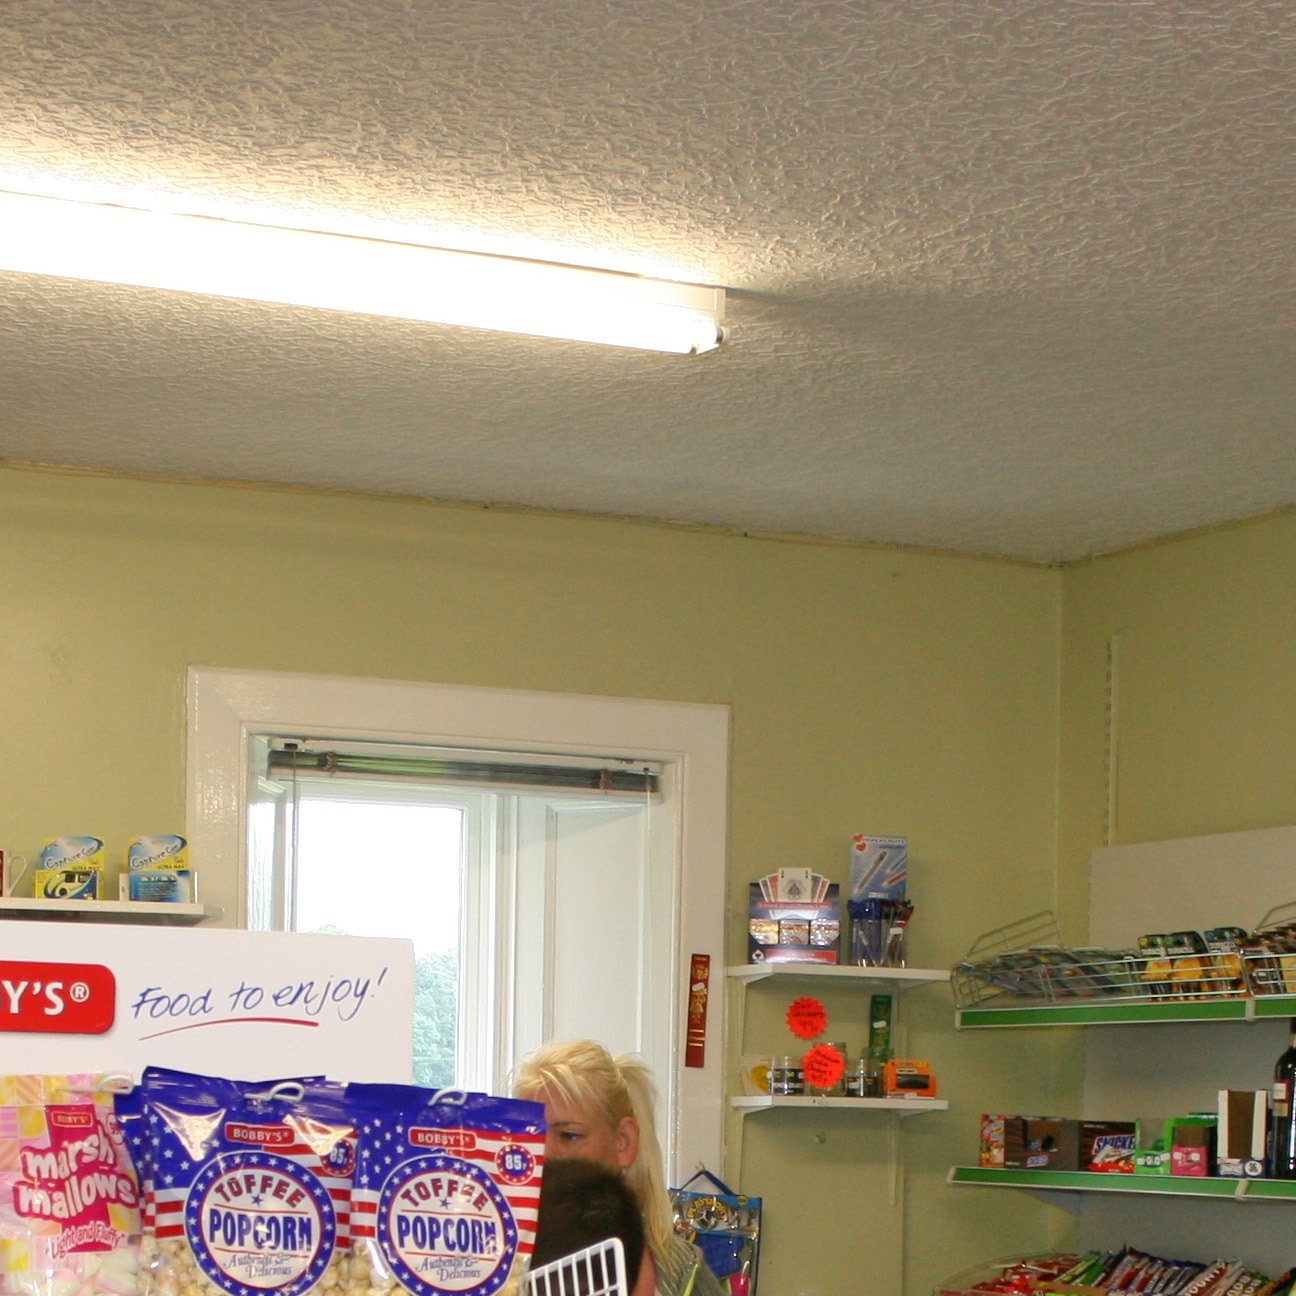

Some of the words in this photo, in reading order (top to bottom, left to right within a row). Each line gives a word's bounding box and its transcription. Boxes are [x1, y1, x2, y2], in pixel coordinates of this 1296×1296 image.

[131, 986, 214, 1020] Food
[229, 980, 263, 1012] to
[271, 967, 389, 1022] enjoy!
[25, 1121, 115, 1181] marsh
[1094, 1134, 1135, 1152] SNICKE
[18, 1172, 139, 1219] mallows
[214, 1174, 306, 1208] TOFFEE
[401, 1177, 488, 1211] TOFFEE
[209, 1208, 312, 1252] POPCORN
[397, 1214, 496, 1255] POPCORN
